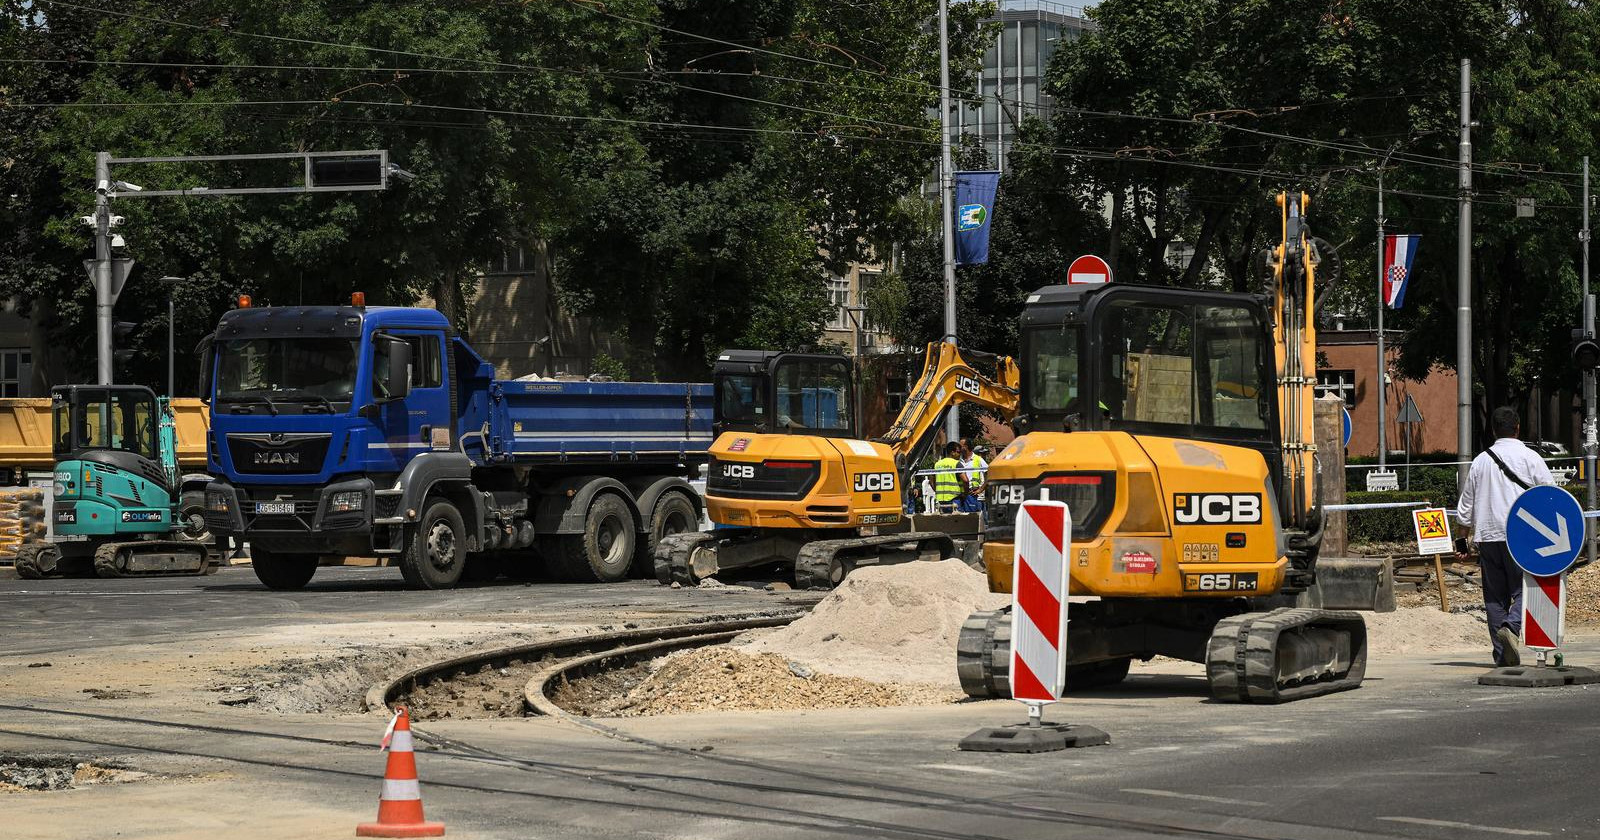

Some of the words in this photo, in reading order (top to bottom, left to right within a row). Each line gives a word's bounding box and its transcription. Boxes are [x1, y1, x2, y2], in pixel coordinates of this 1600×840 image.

[956, 375, 980, 395] JCB
[255, 452, 299, 464] MAN
[723, 464, 755, 478] JCB
[854, 473, 894, 491] JCB
[991, 484, 1025, 505] JCB
[1175, 494, 1261, 523] JCB
[863, 515, 877, 524] 85
[1199, 574, 1231, 590] 65
[1238, 580, 1257, 590] R-1
